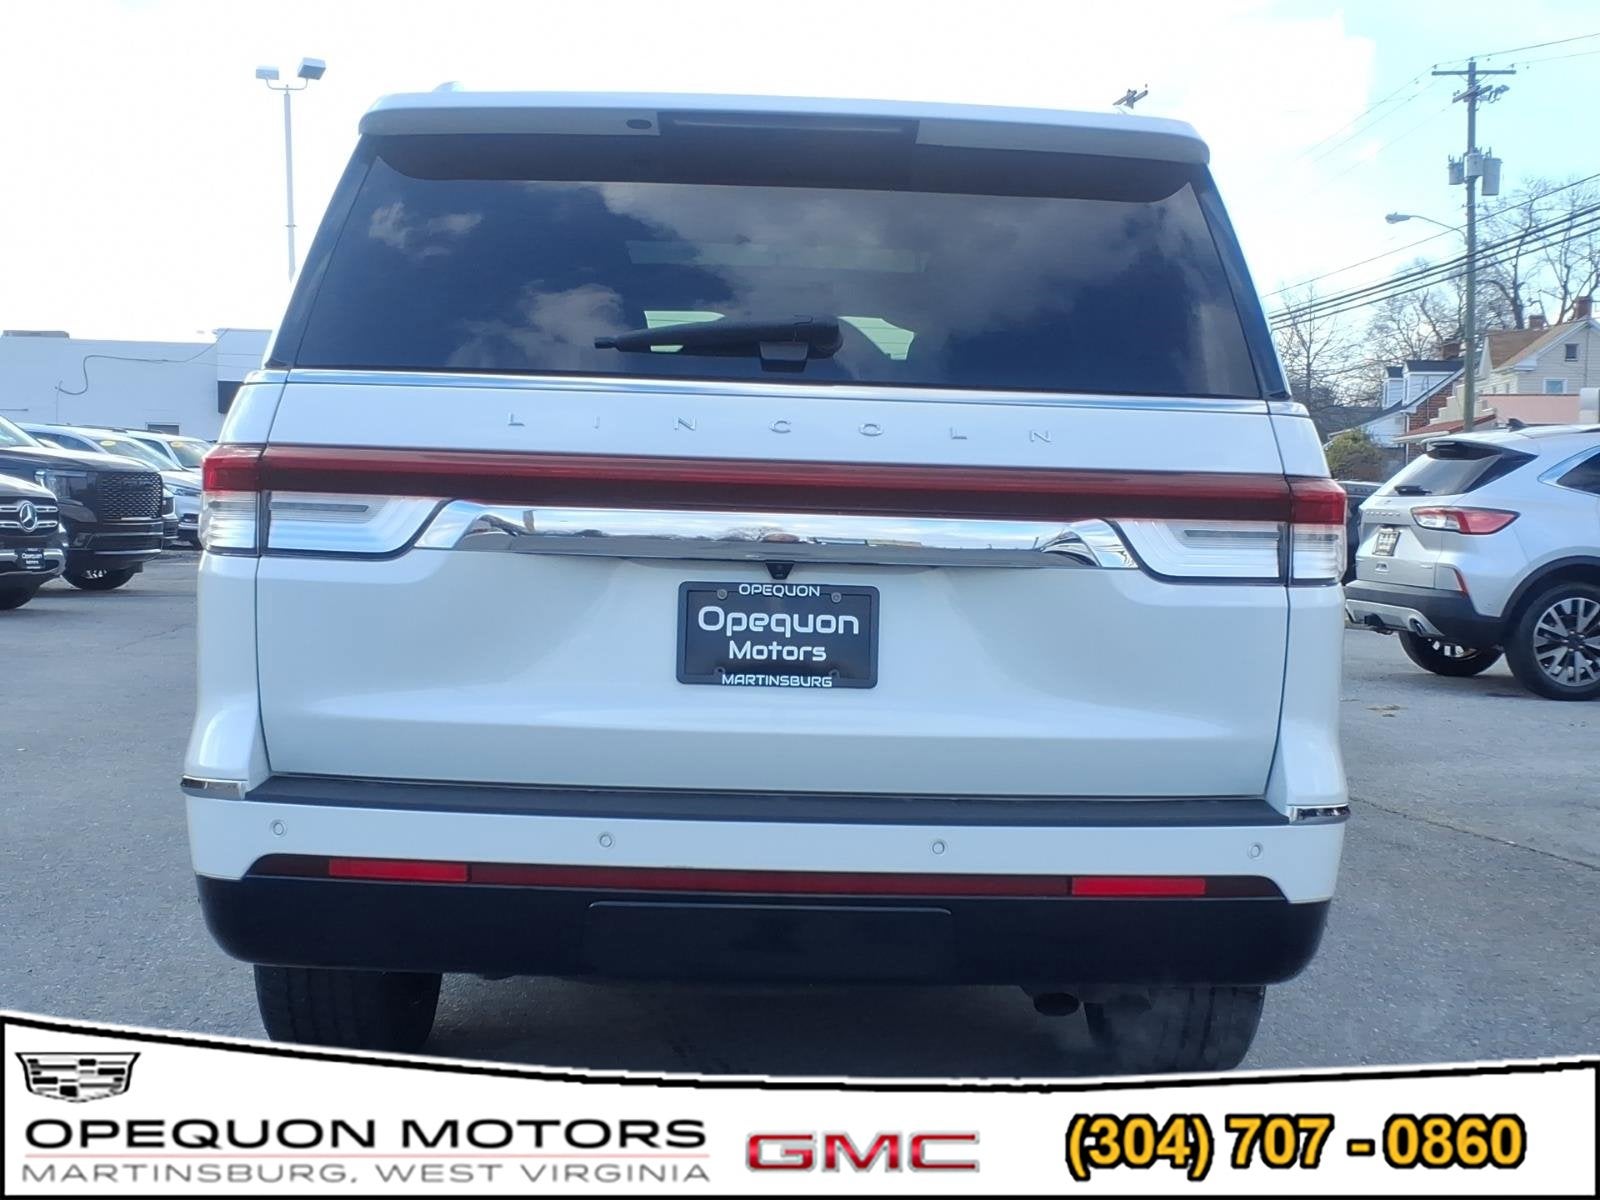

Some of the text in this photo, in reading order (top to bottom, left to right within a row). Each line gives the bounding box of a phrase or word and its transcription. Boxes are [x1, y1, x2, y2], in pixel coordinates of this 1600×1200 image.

[507, 411, 1051, 443] LINCOLN
[738, 583, 820, 597] OPEQUON
[698, 605, 859, 637] Opequon
[729, 640, 827, 661] Motors
[721, 673, 833, 687] MARTINSBURG
